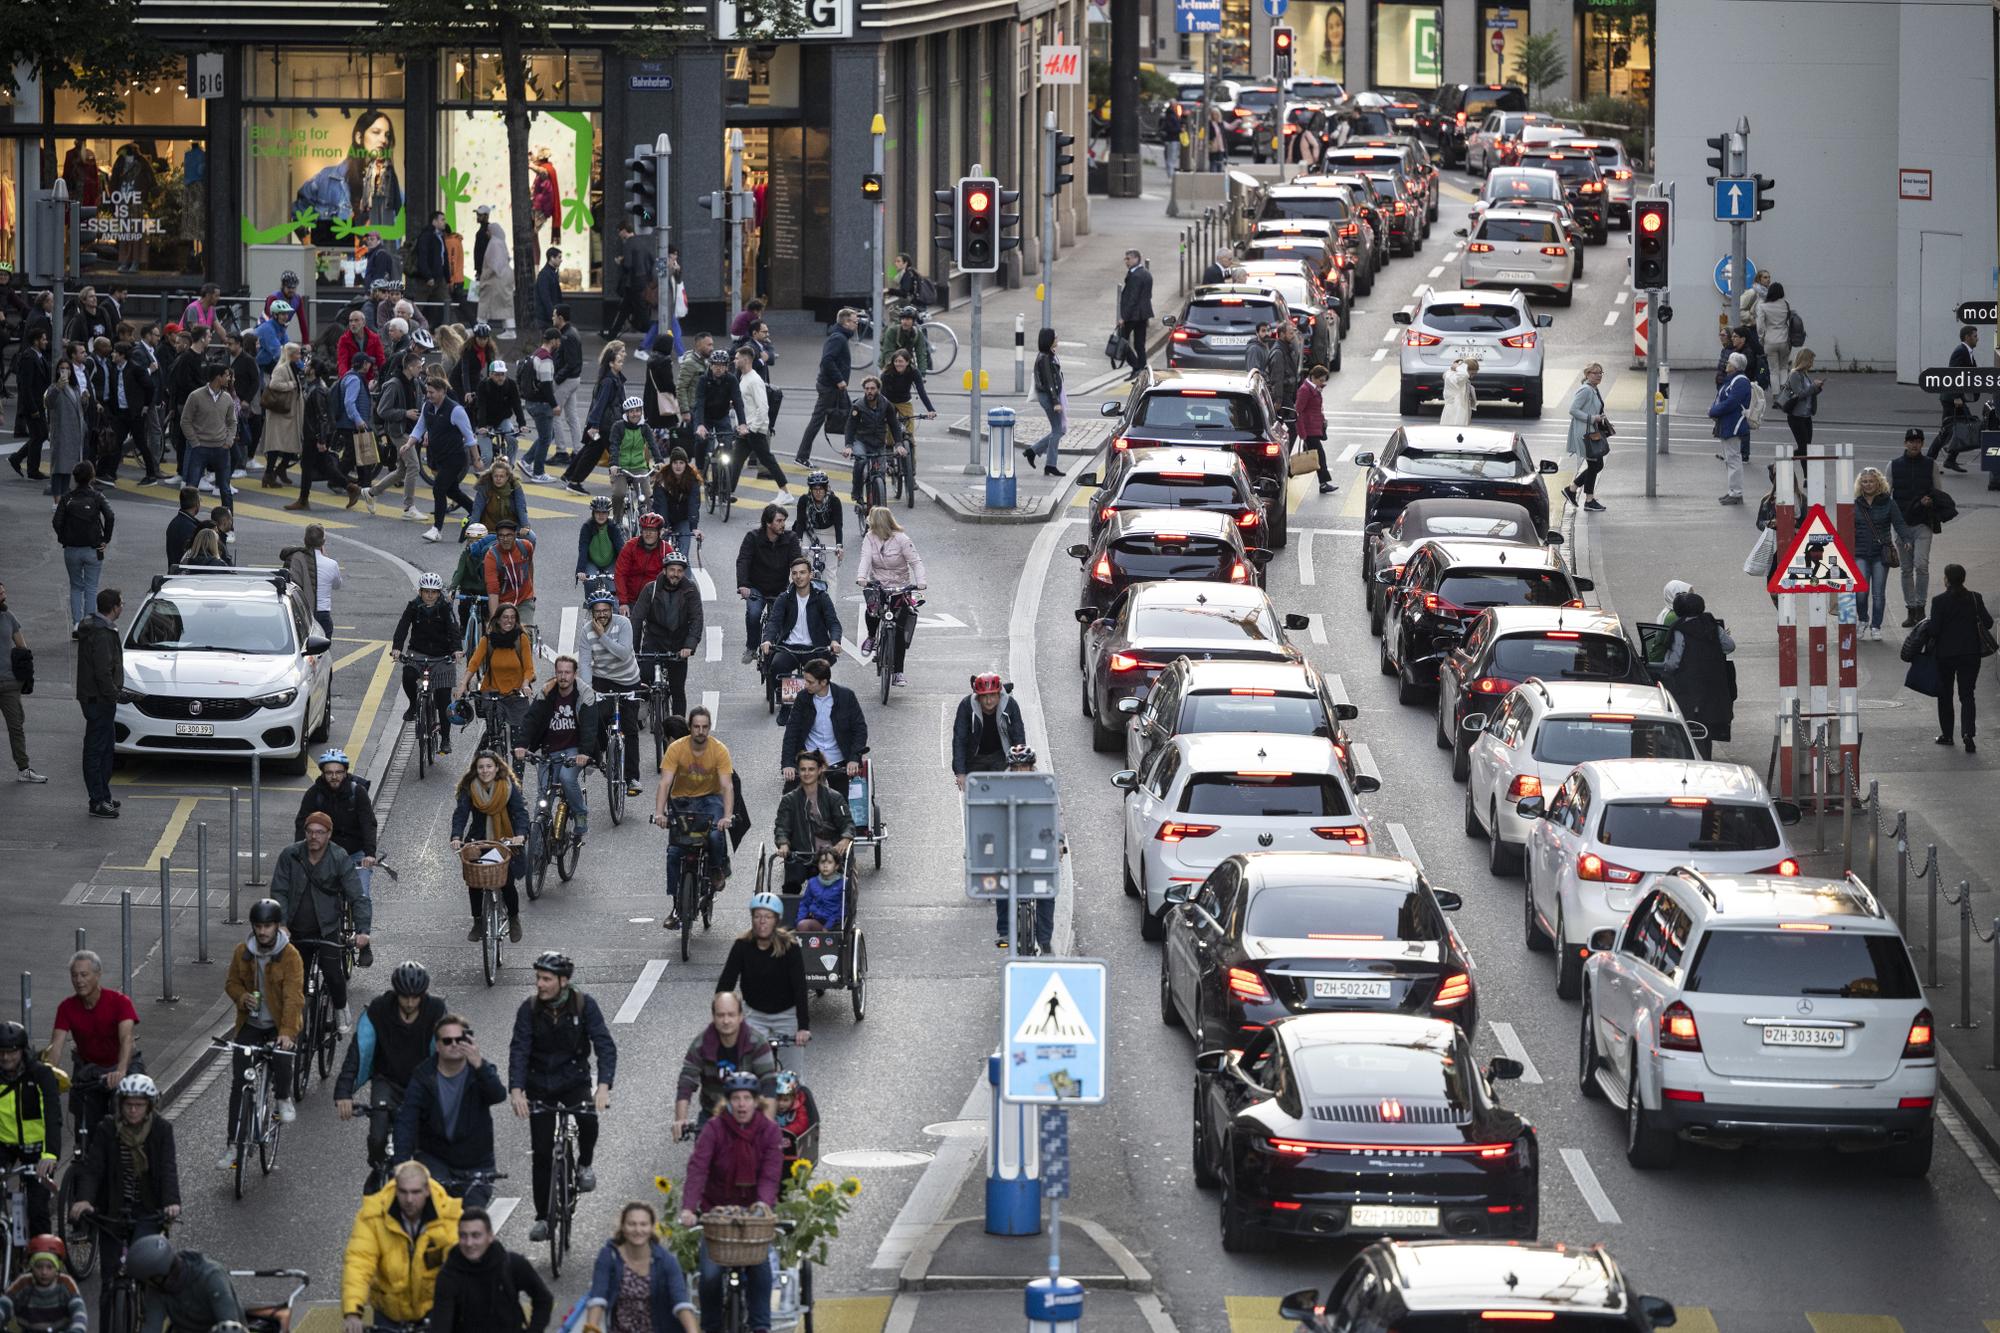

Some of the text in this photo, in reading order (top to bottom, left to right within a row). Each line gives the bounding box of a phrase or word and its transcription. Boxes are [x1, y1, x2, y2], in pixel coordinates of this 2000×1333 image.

[736, 0, 835, 28] BG
[200, 73, 222, 93] BIG
[310, 127, 329, 140] for
[311, 147, 342, 158] mon
[347, 146, 392, 158] Amour
[102, 191, 142, 204] LOVE
[115, 205, 129, 217] IS
